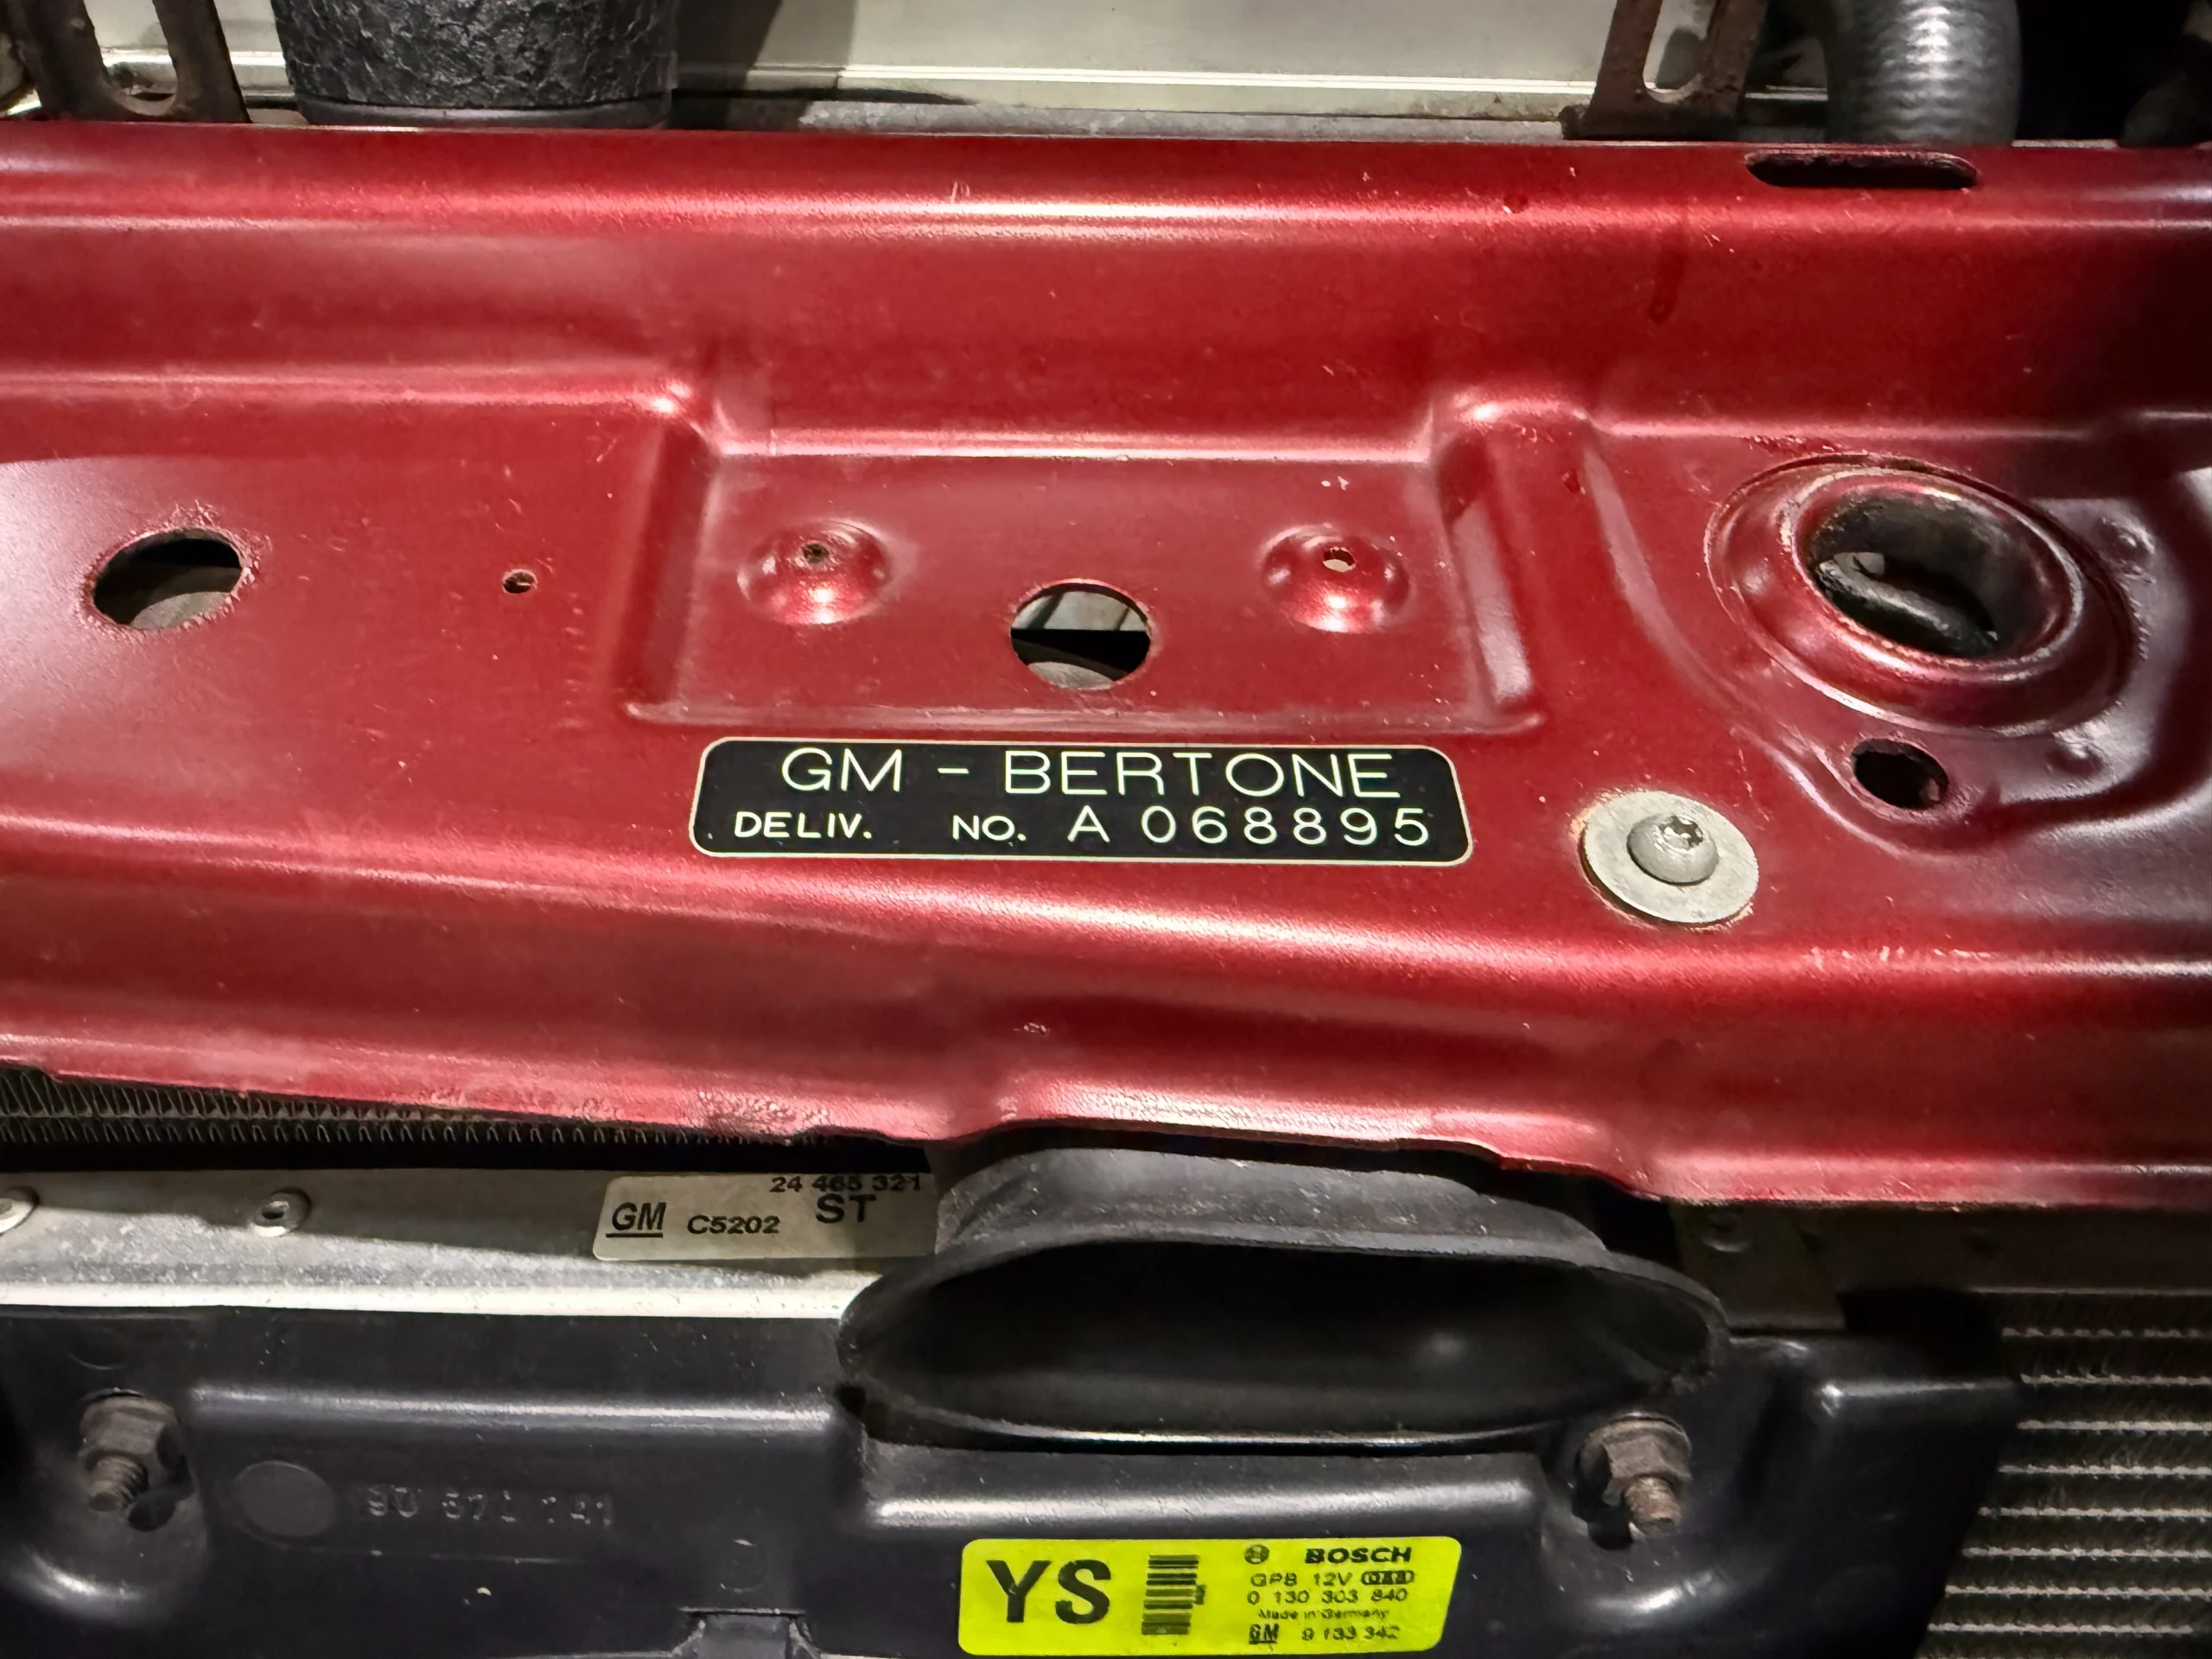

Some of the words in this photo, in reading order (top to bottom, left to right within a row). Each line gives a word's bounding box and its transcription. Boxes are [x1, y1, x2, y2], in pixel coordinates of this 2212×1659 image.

[781, 747, 903, 792] GM
[937, 766, 970, 775] -
[1005, 751, 1402, 798] BERTONE
[734, 810, 873, 840] DELIV.
[951, 814, 1027, 841] NO.
[1067, 804, 1110, 842] A
[1141, 805, 1430, 847] 068895
[768, 1176, 803, 1193] 24
[871, 1173, 921, 1192] 321
[611, 1201, 667, 1231] GM
[815, 1192, 877, 1224] ST
[686, 1214, 781, 1235] C5202
[1304, 1546, 1412, 1564] BOSCH
[1313, 1572, 1353, 1586] 12V
[985, 1558, 1112, 1624] YS
[1274, 1589, 1310, 1604] 130
[1249, 1623, 1280, 1645] GM
